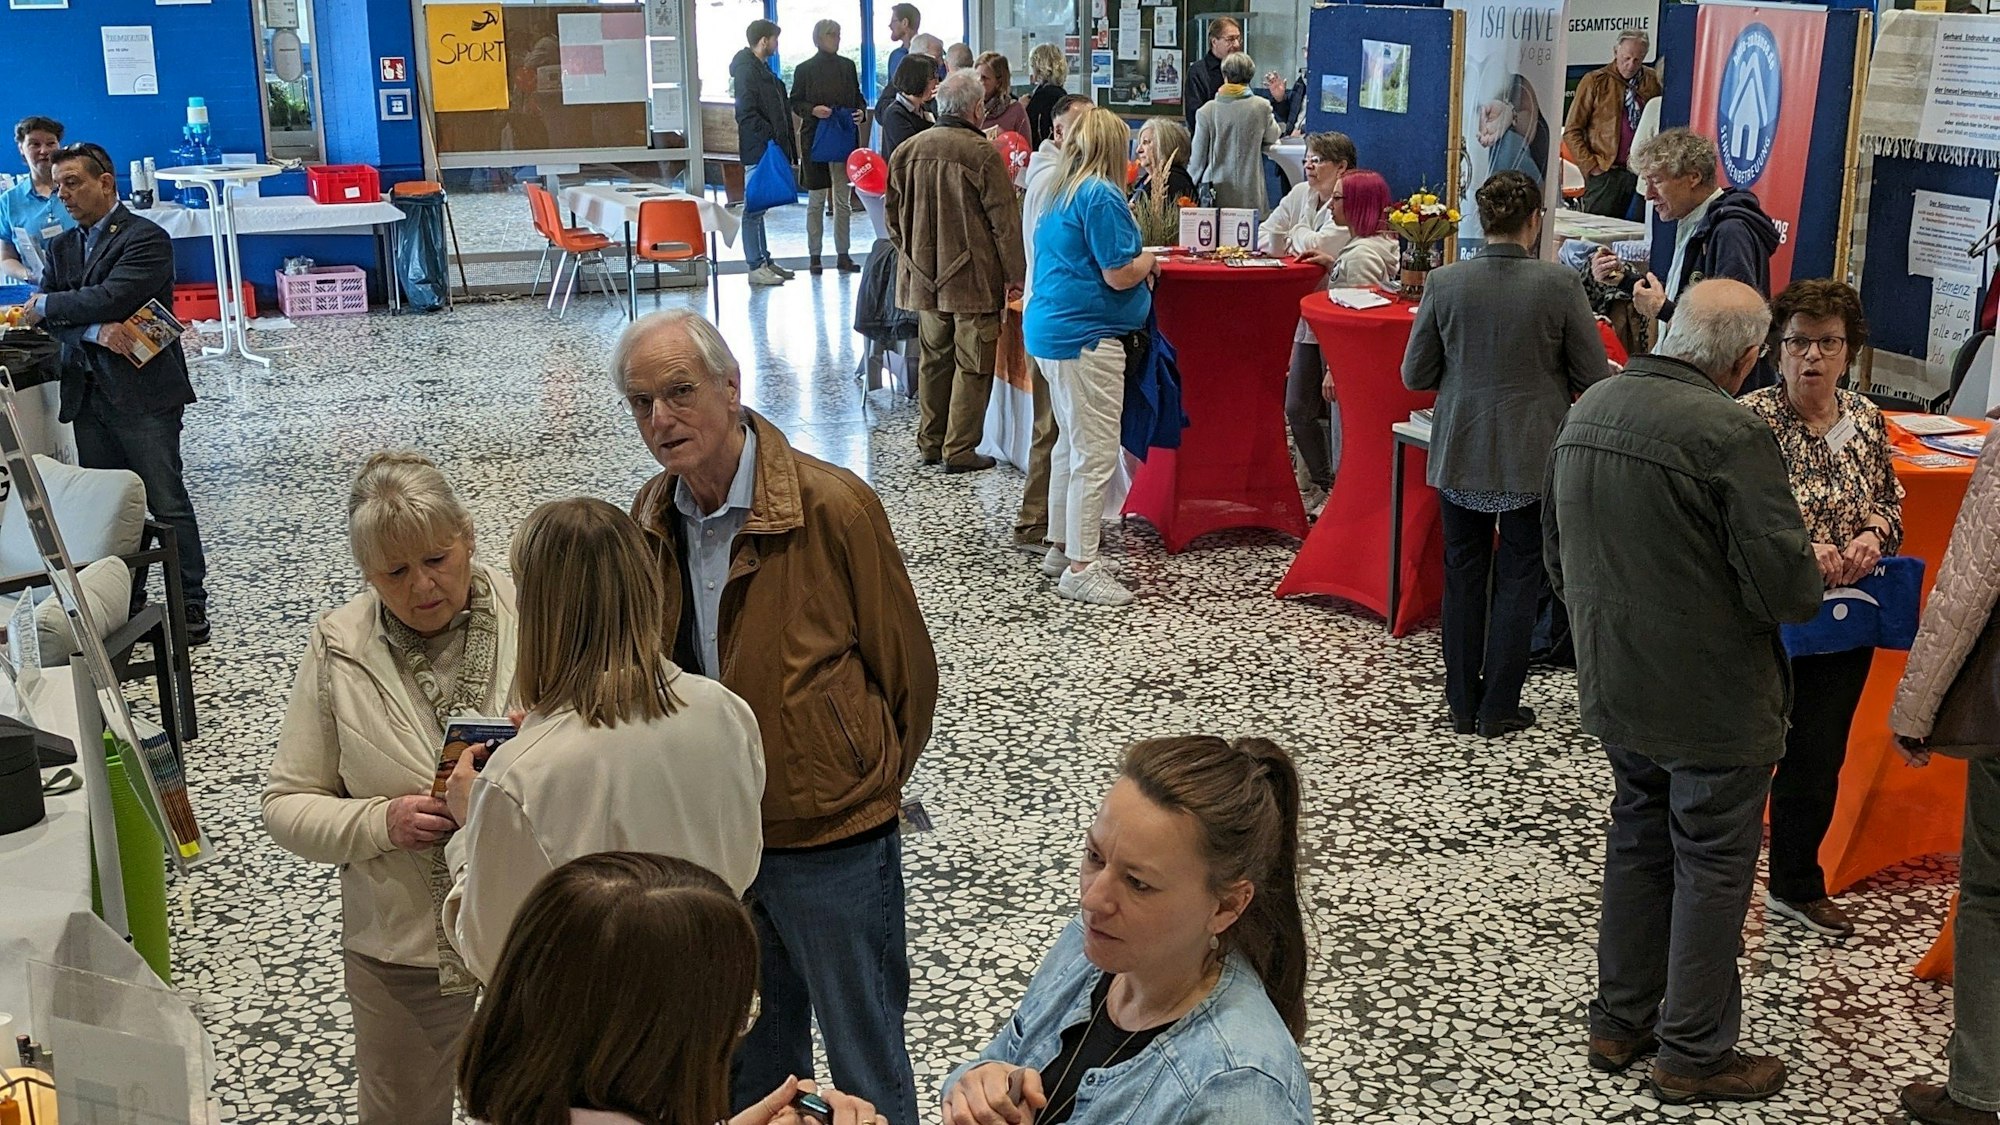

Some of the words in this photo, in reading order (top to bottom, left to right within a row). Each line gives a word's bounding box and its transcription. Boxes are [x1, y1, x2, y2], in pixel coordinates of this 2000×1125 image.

[1480, 5, 1506, 39] ISA
[1512, 7, 1556, 42] CAVE
[1569, 16, 1649, 32] GESAMTSCHULE
[1943, 33, 1962, 41] Gerhard
[437, 33, 504, 65] SPORT
[1520, 47, 1552, 65] yoga
[1720, 124, 1771, 184] SENIORENBETREUUNG
[1936, 278, 1970, 297] Demenz
[1931, 300, 1954, 319] geht
[1956, 308, 1971, 321] uns
[1933, 323, 1950, 339] alle
